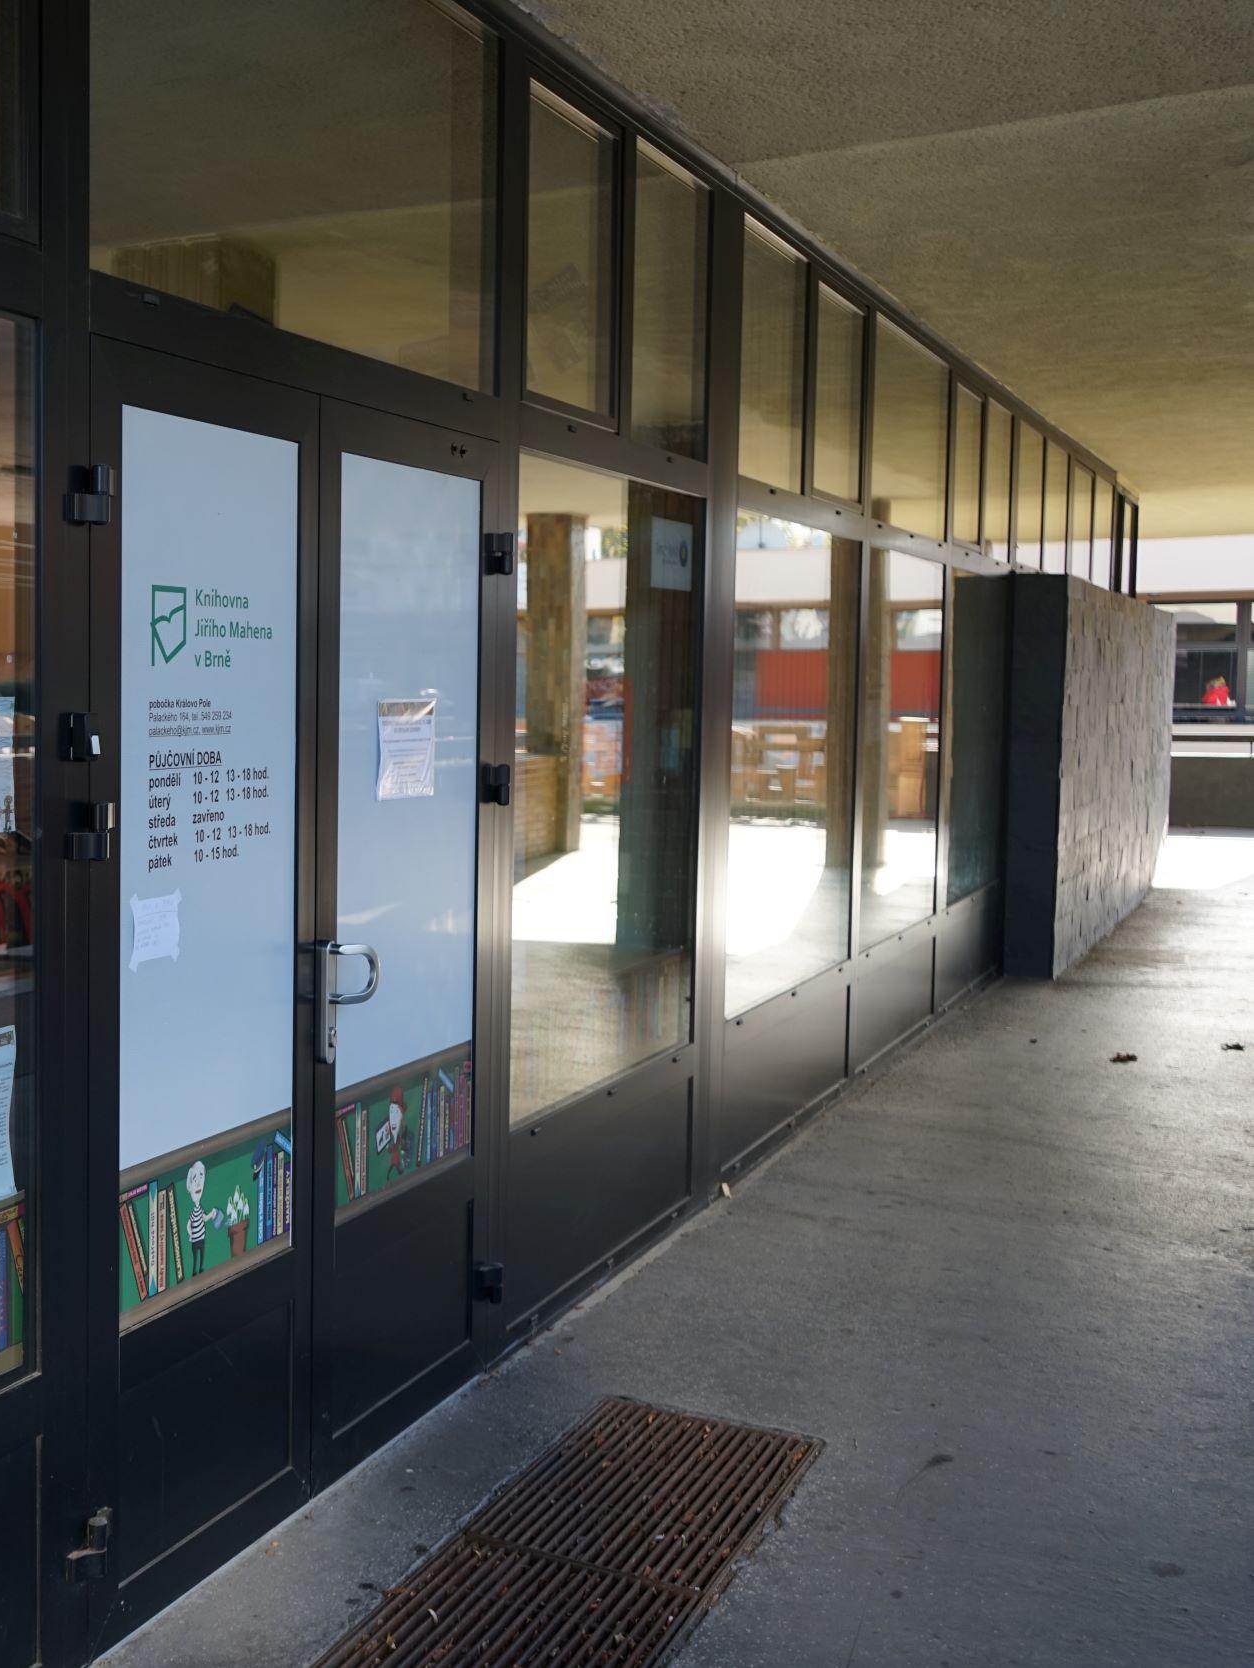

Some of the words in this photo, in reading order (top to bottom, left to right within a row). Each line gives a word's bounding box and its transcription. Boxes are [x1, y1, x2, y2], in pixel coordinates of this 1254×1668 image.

[195, 589, 249, 609] Knihovna
[195, 618, 226, 638] Jiřího
[229, 621, 273, 640] Mahena
[195, 654, 202, 667] v
[204, 649, 232, 668] Brně
[149, 699, 174, 711] pobočka
[199, 698, 211, 708] Pole
[149, 748, 195, 769] PŮJČOVNÍ
[197, 750, 222, 766] DOBA
[149, 772, 181, 792] pondělí
[193, 771, 203, 785] 10
[210, 770, 219, 784] 12
[226, 768, 235, 782] 13
[242, 767, 251, 781] 18
[252, 767, 269, 780] hod.
[149, 793, 171, 810] úterý
[193, 790, 203, 804] 10
[210, 789, 219, 803] 12
[226, 788, 235, 801] 13
[242, 786, 251, 800] 18
[252, 785, 269, 799] hod.
[148, 813, 176, 829] středa
[192, 809, 225, 825] zavřeno
[148, 832, 178, 849] čtvrtek
[195, 829, 205, 843] 10
[212, 827, 221, 841] 12
[228, 825, 237, 839] 13
[244, 823, 252, 837] 18
[254, 821, 271, 836] hod.
[148, 853, 172, 873] pátek
[194, 849, 203, 863] 10
[210, 846, 220, 860] 15
[222, 844, 239, 859] hod.
